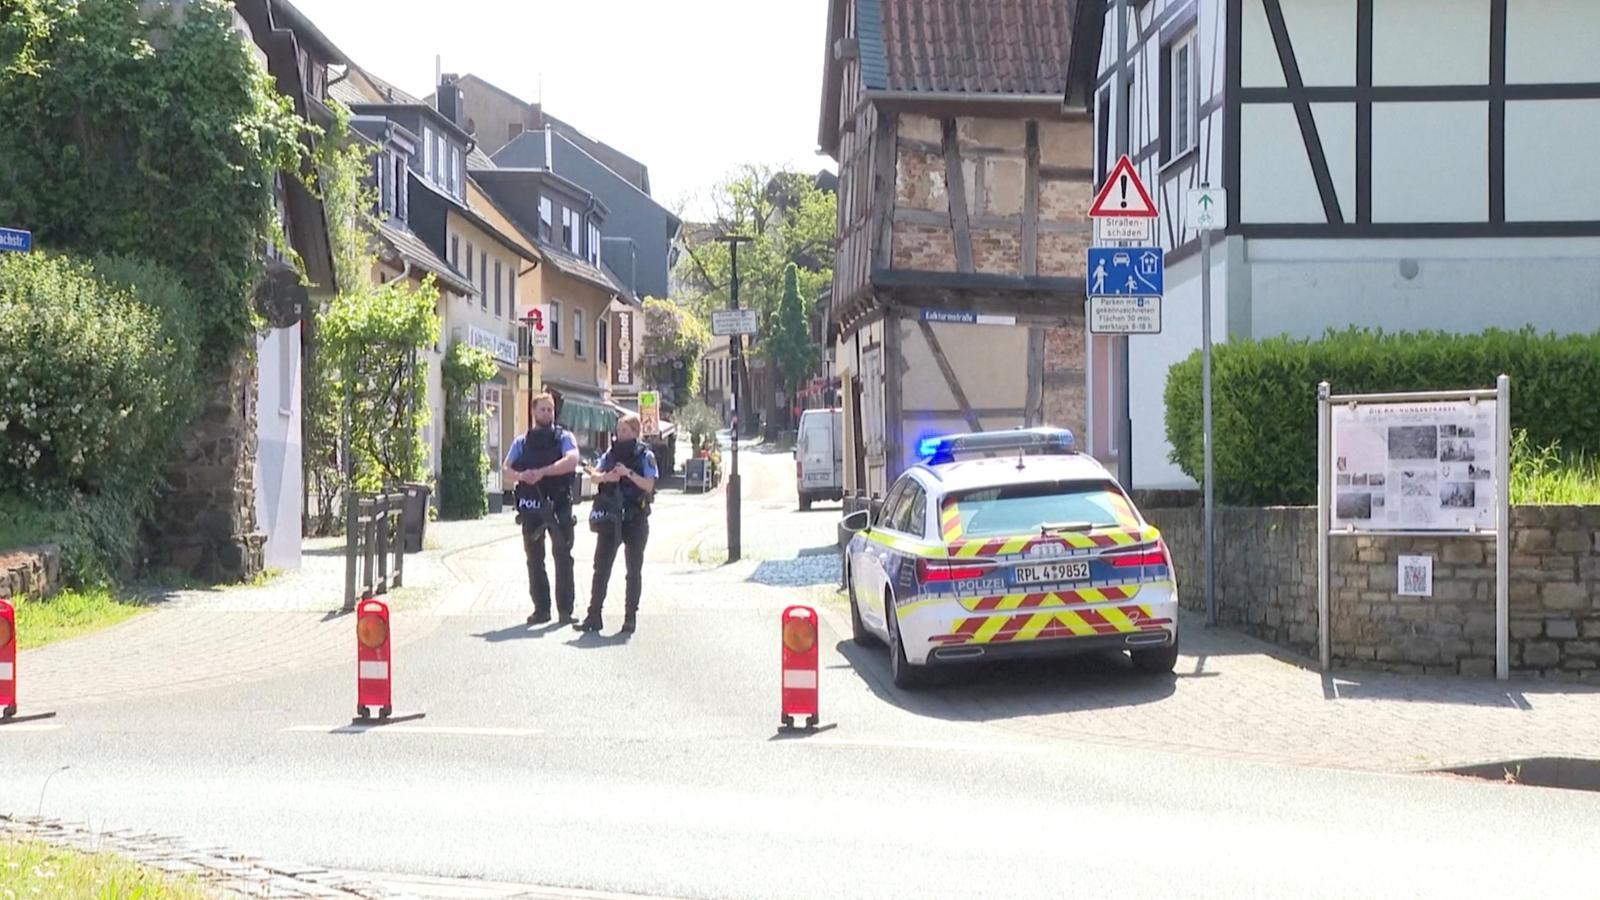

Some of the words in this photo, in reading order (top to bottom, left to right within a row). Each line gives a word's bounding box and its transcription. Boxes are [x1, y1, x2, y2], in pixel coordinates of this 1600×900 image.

[1106, 217, 1142, 226] Straßen-
[1016, 565, 1040, 581] RPL
[1043, 564, 1050, 580] 4
[1058, 563, 1088, 578] 9852
[957, 578, 1006, 592] POLIZEI
